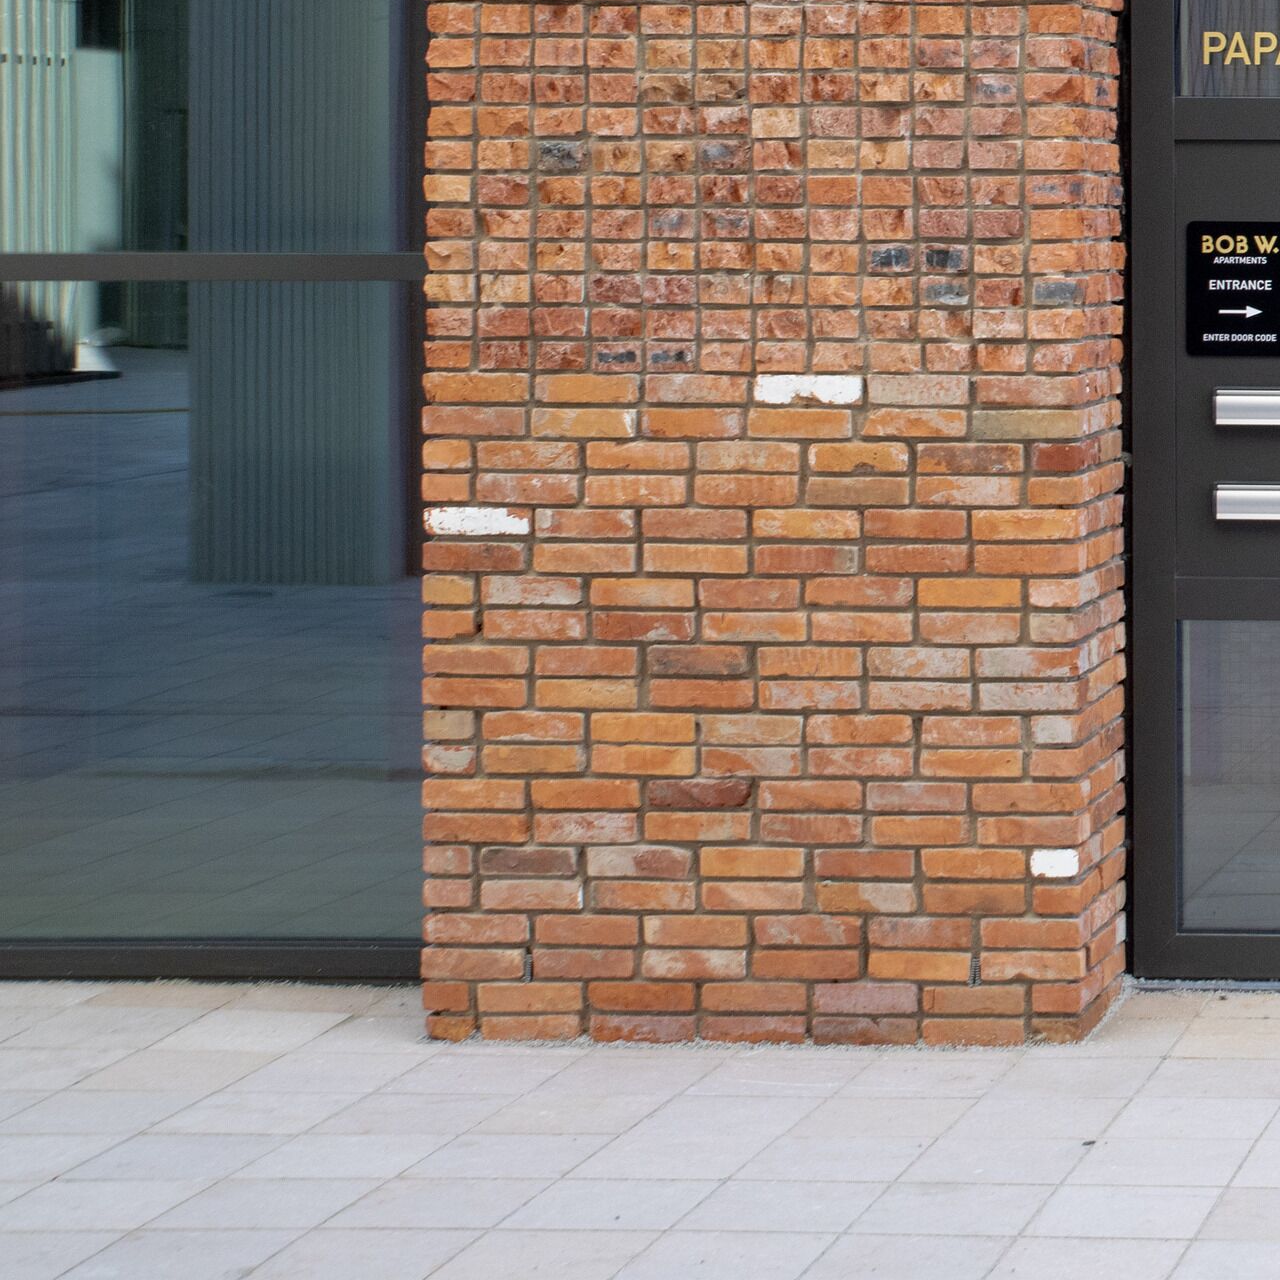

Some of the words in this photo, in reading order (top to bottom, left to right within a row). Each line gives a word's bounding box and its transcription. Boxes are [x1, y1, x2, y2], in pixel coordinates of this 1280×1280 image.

[1201, 234, 1249, 254] BOB
[1253, 235, 1280, 254] W.
[1213, 256, 1268, 264] APARTMENTS
[1208, 279, 1273, 291] ENTRANCE
[1202, 333, 1229, 342] ENTER
[1230, 333, 1254, 342] DOOR
[1255, 333, 1278, 342] CODE
